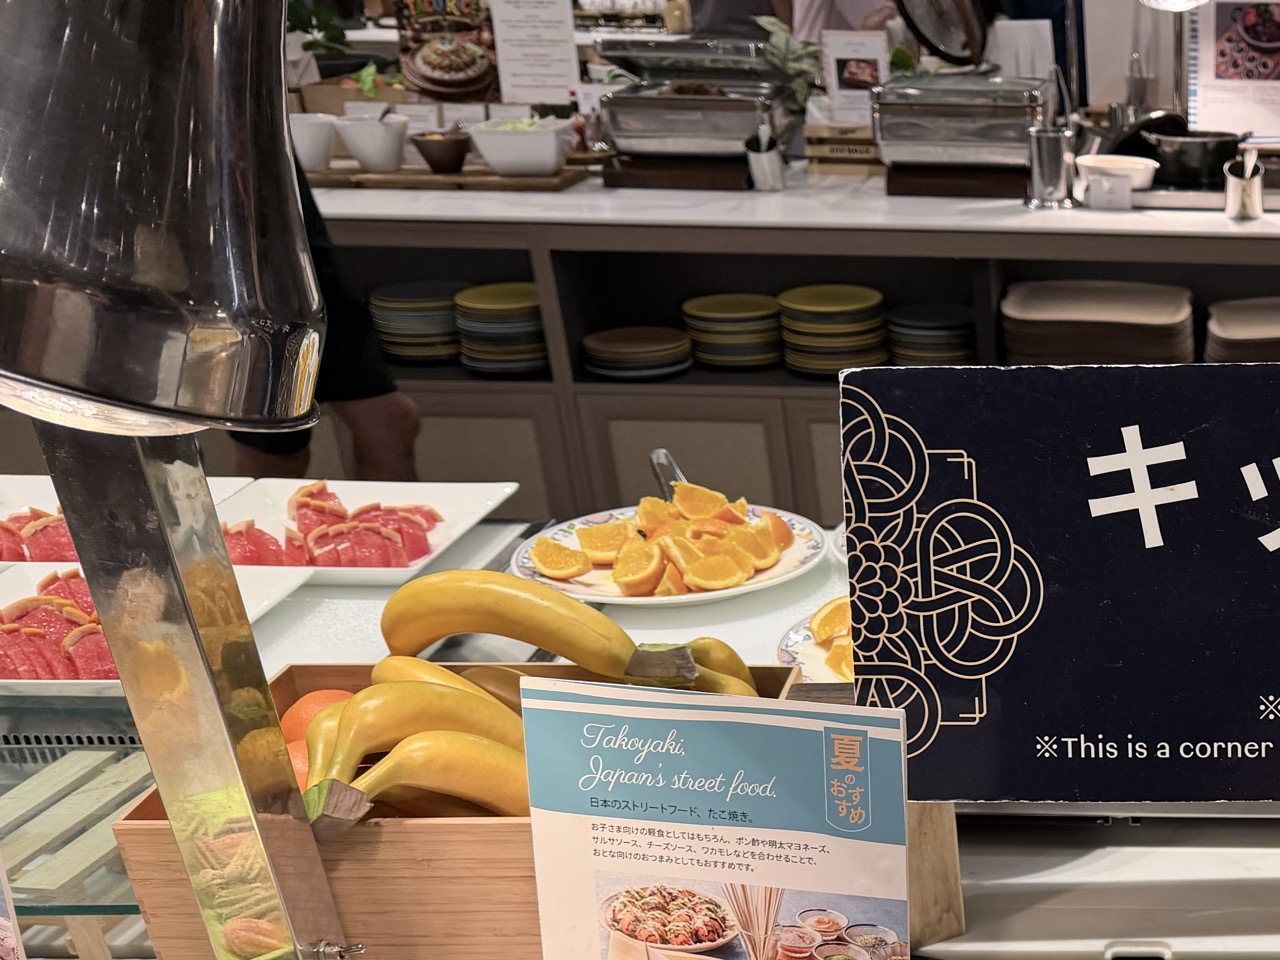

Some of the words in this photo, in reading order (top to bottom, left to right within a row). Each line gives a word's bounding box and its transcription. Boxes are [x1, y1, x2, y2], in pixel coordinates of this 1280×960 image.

[580, 723, 685, 765] Takoyaki,
[1128, 734, 1147, 758] is
[1157, 743, 1169, 757] a
[1180, 742, 1273, 758] corner
[671, 770, 726, 793] street
[726, 769, 777, 802] food.
[830, 733, 866, 824] 夏のおすすめ
